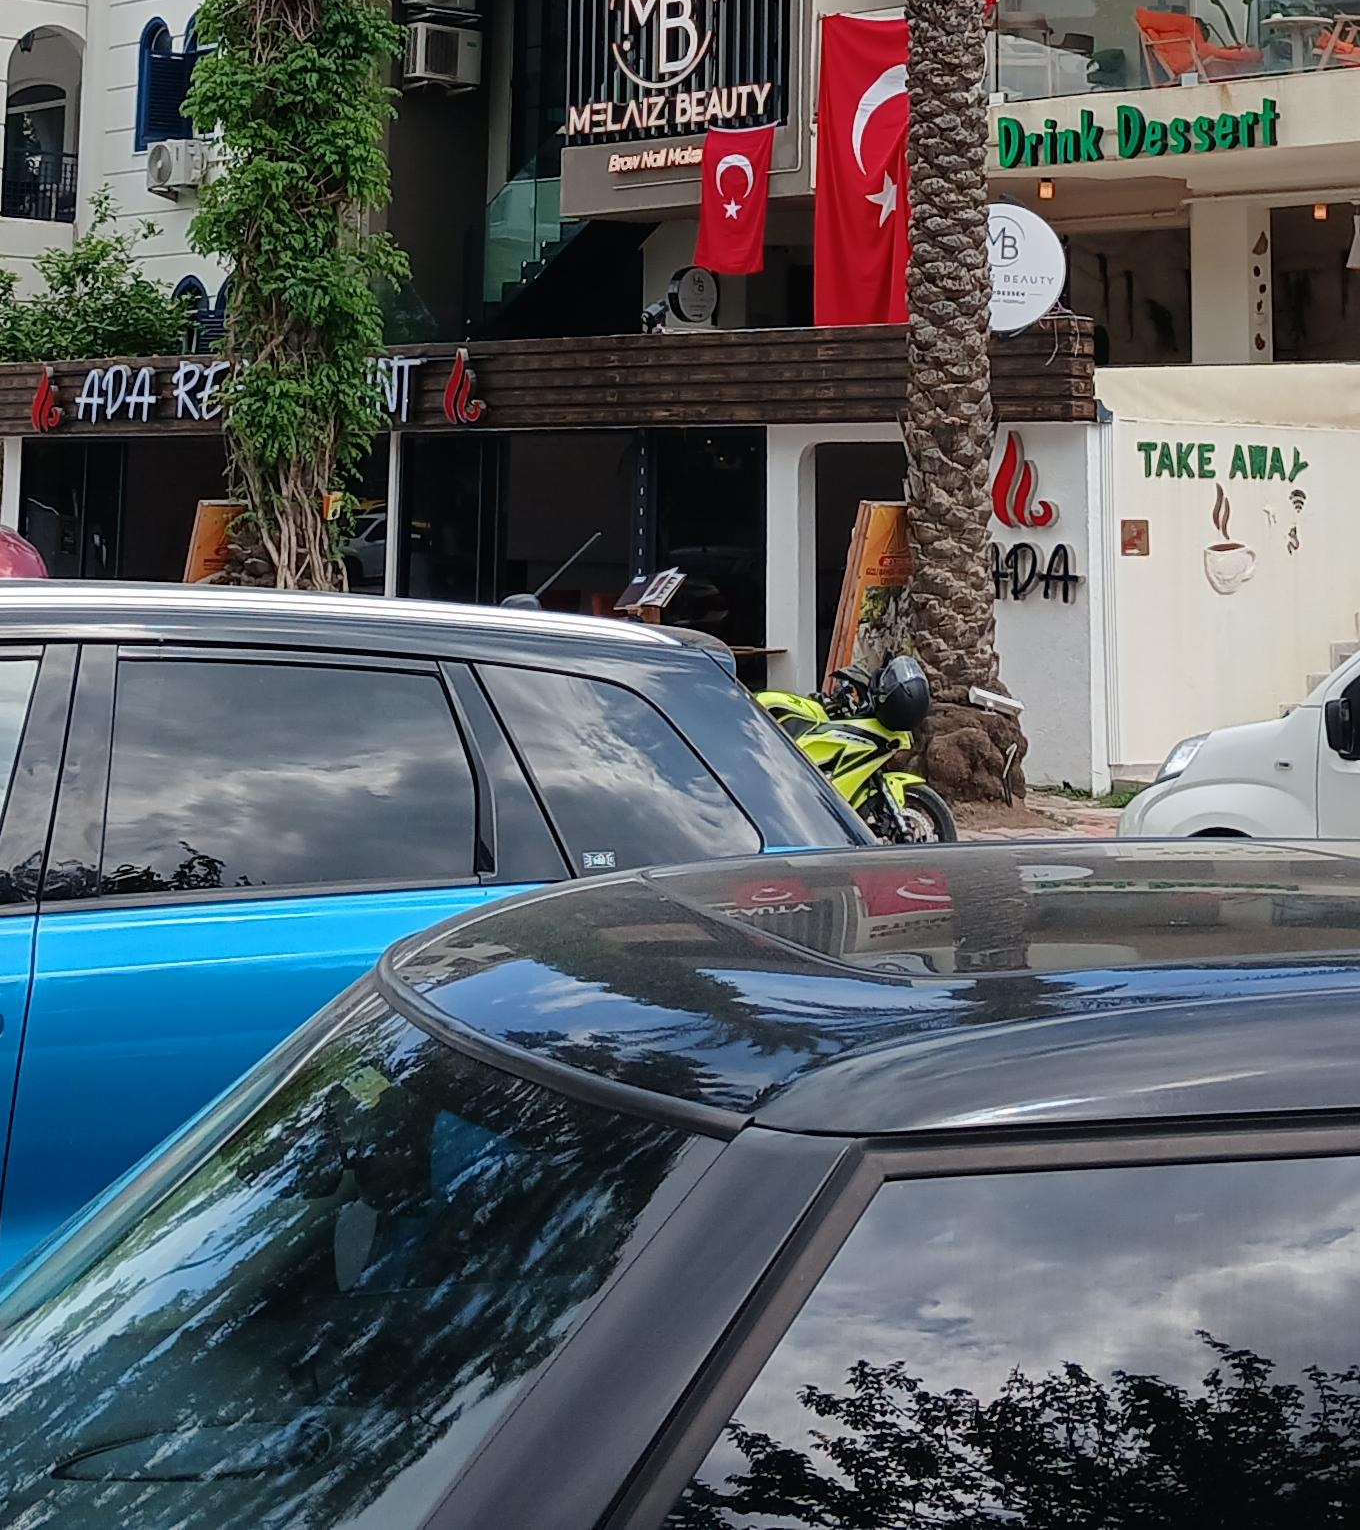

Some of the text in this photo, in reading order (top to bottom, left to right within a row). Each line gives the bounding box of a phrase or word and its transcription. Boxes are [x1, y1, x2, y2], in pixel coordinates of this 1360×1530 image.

[568, 82, 772, 136] MELAIZ BEAUTY
[997, 98, 1280, 168] Drink Dessert
[608, 145, 703, 172] Brow Nail Make
[1003, 273, 1055, 286] BEAUTY
[74, 364, 157, 425] ADA
[1137, 441, 1309, 483] TAKE AWAY
